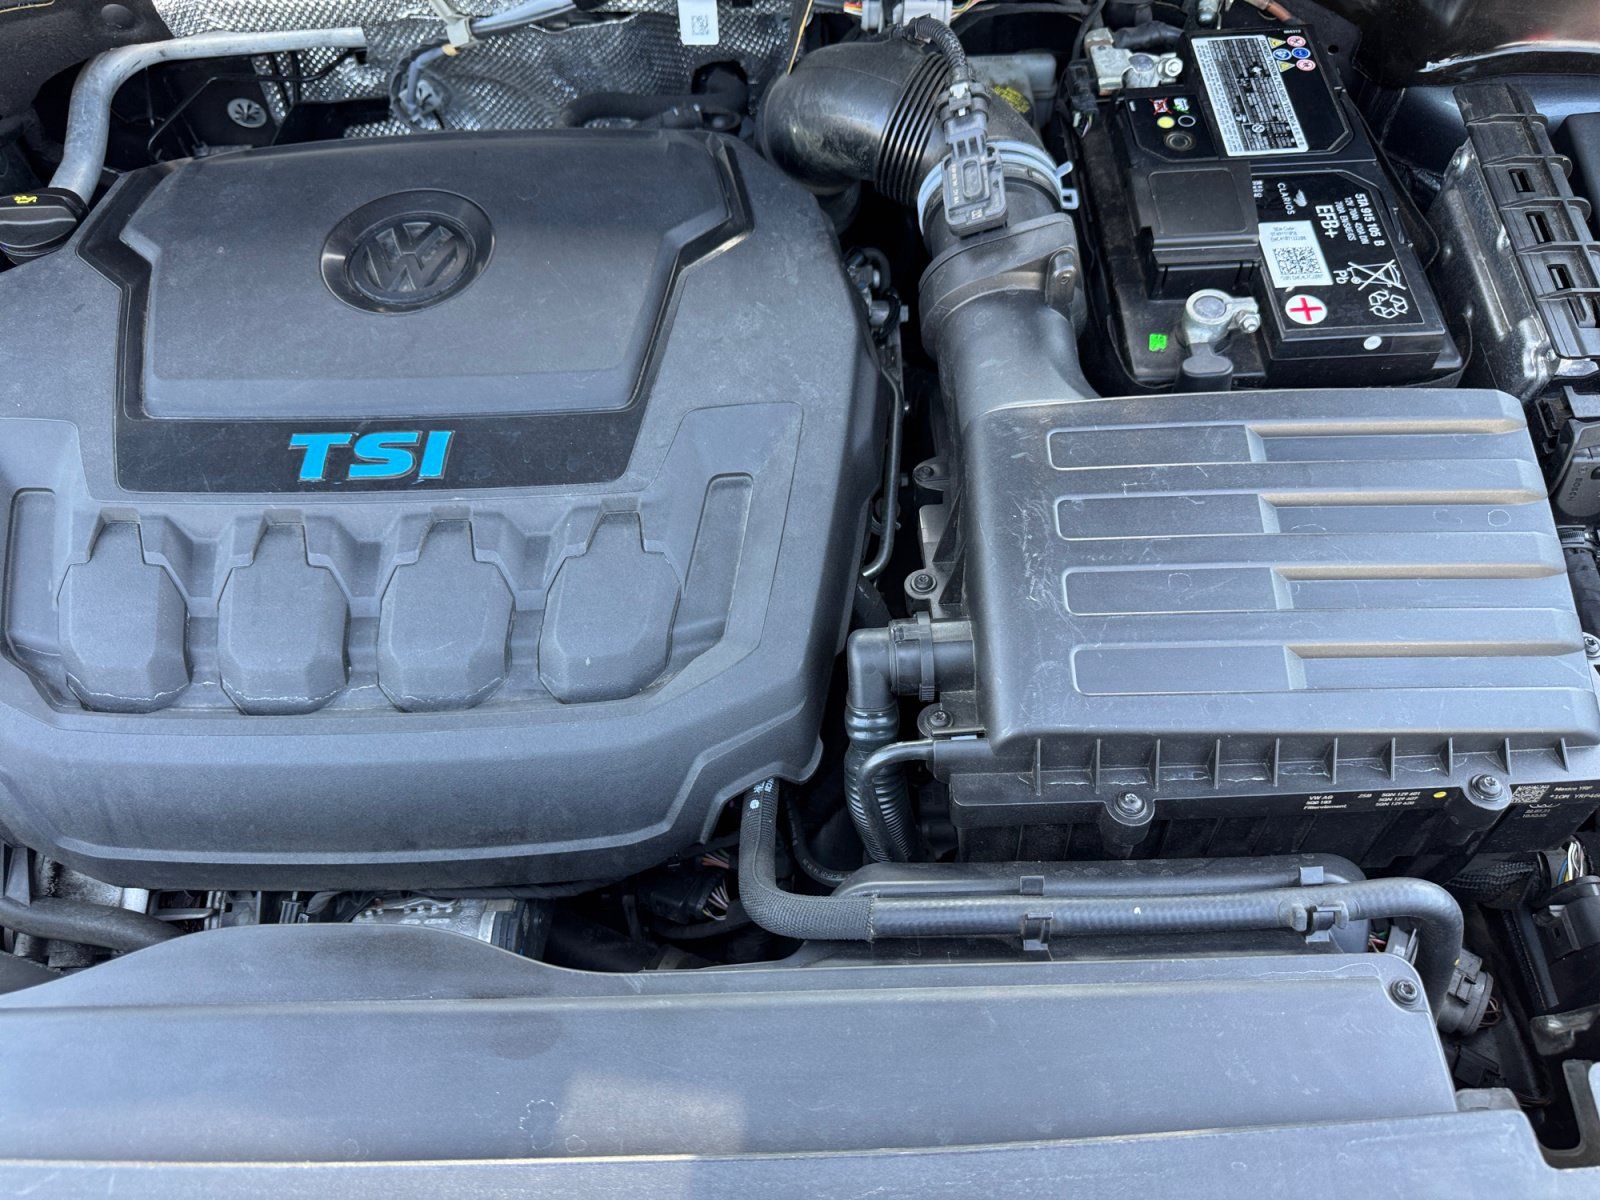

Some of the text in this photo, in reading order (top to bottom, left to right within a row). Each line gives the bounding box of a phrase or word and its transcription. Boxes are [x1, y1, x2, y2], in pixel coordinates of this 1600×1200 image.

[1277, 182, 1296, 215] CLARIOS
[1315, 204, 1340, 239] EFB+
[1360, 207, 1376, 222] 915
[1367, 223, 1382, 237] 105
[1333, 269, 1349, 285] Pb
[289, 430, 455, 481] TSI
